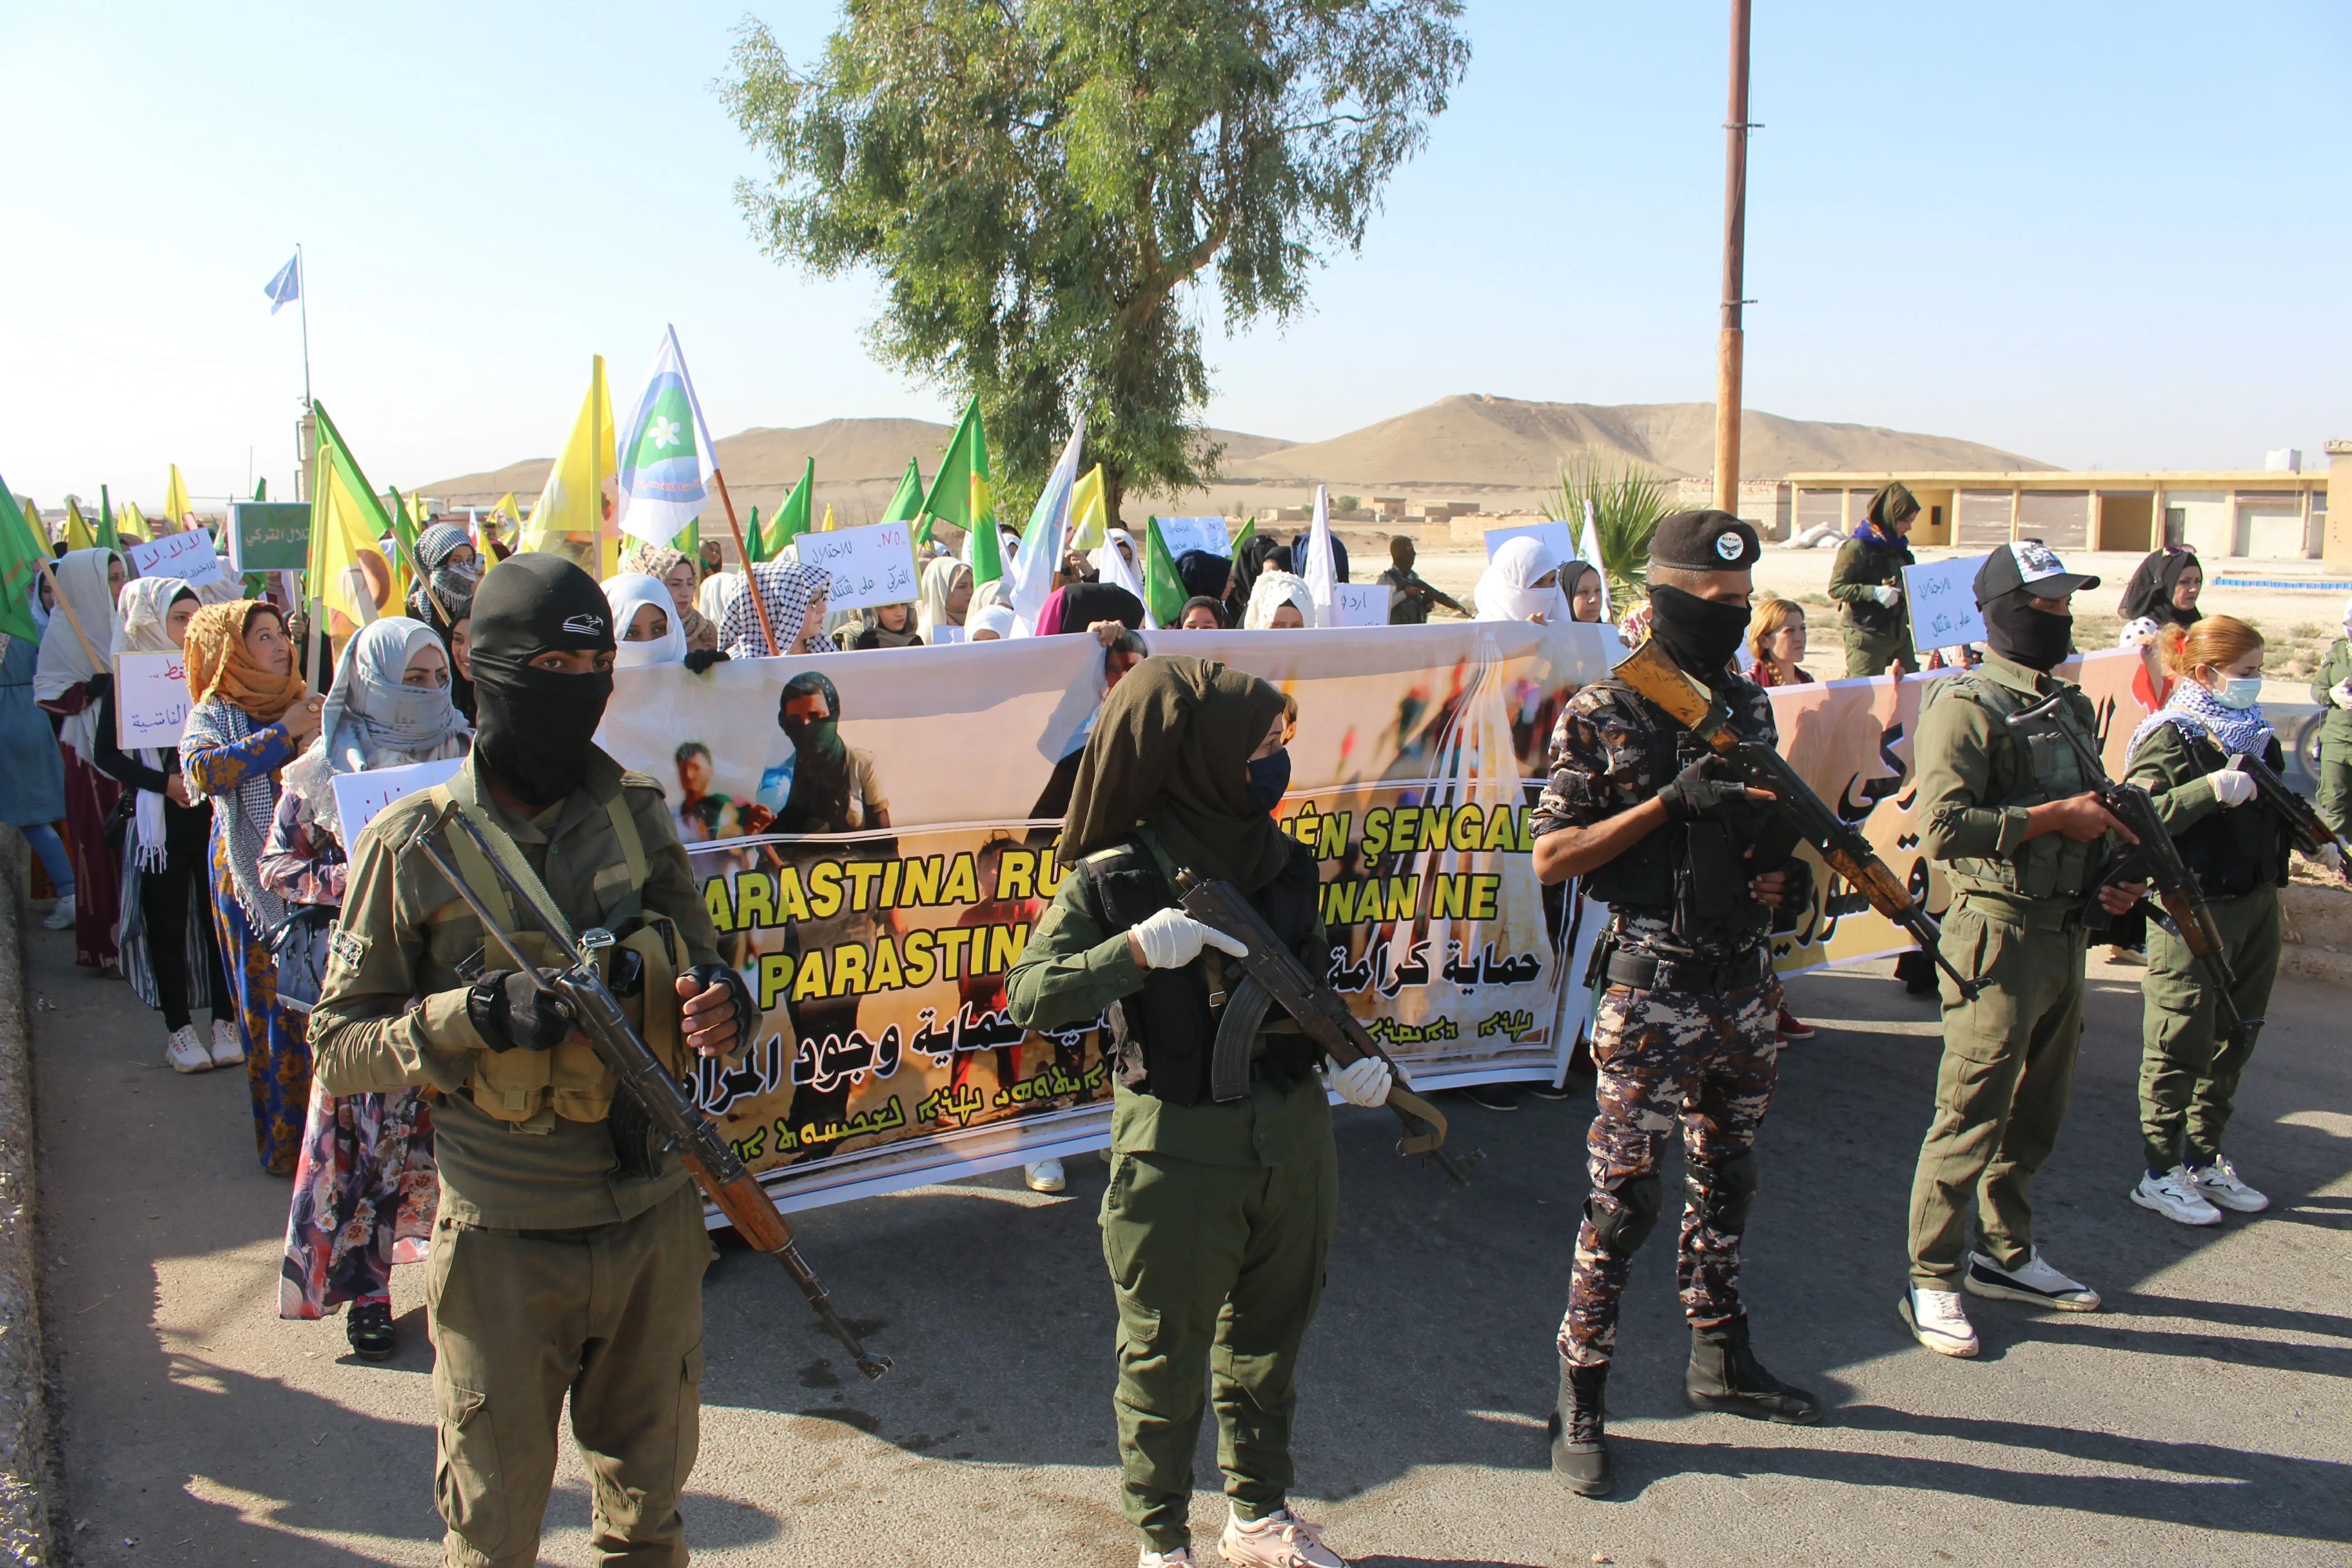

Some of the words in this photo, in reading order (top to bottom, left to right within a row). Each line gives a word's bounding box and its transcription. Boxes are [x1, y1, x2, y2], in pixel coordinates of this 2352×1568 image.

[245, 528, 284, 547] التركي
[812, 540, 853, 565] للاحتلال
[858, 576, 875, 595] على
[703, 851, 980, 936] ARASTINA
[758, 921, 1031, 1011] PARASTIN
[1318, 873, 1420, 928] NAN
[1430, 872, 1500, 921] NE
[1441, 940, 1542, 996] حماية
[1327, 941, 1432, 1000] كرامة
[791, 1023, 902, 1093] وجود
